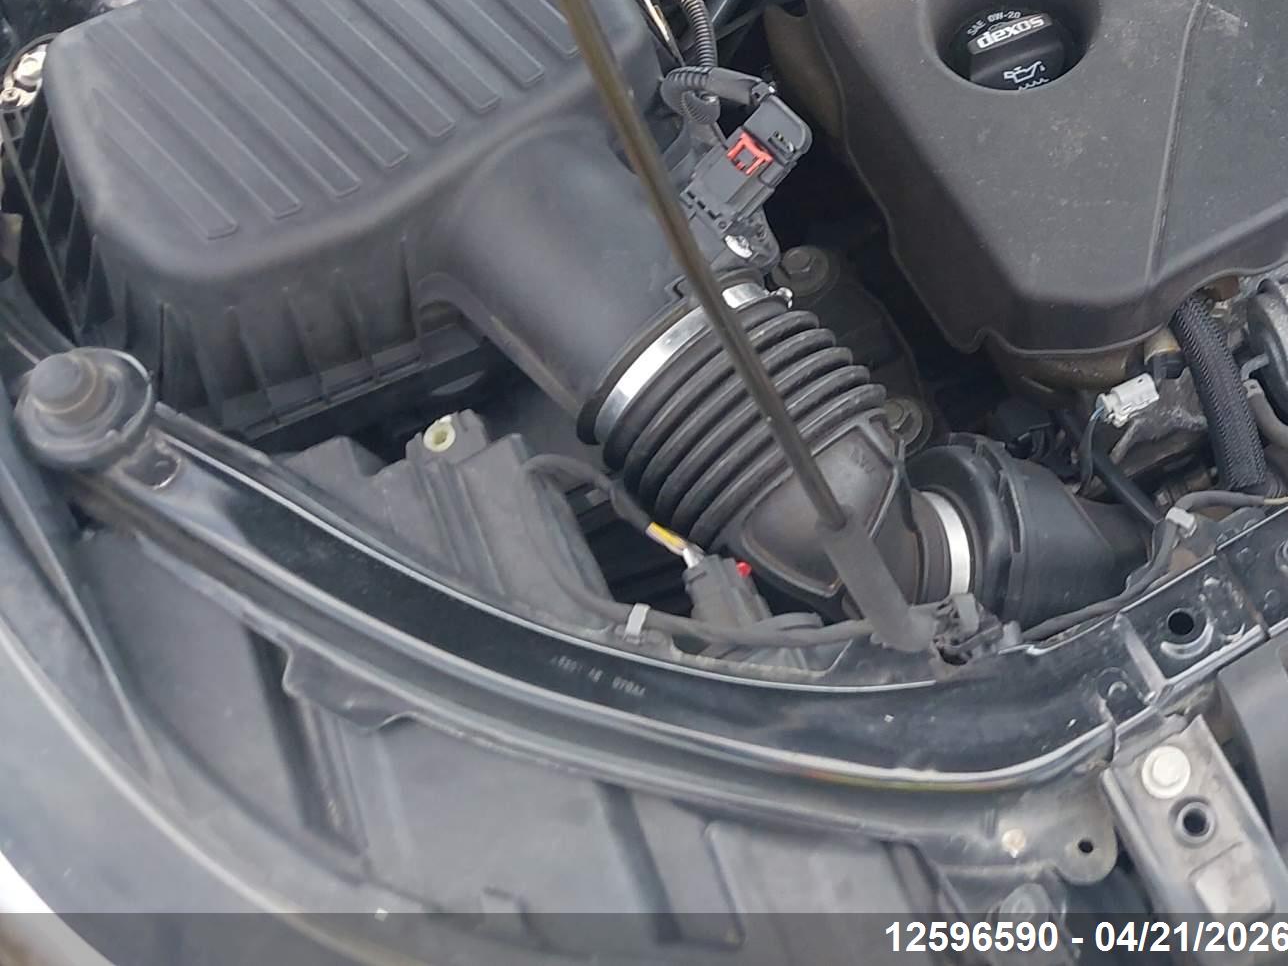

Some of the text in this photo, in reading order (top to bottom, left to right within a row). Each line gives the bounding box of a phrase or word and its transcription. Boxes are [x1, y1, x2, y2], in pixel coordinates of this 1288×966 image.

[967, 11, 1021, 36] SAE 0W-20
[976, 15, 1045, 49] dexos
